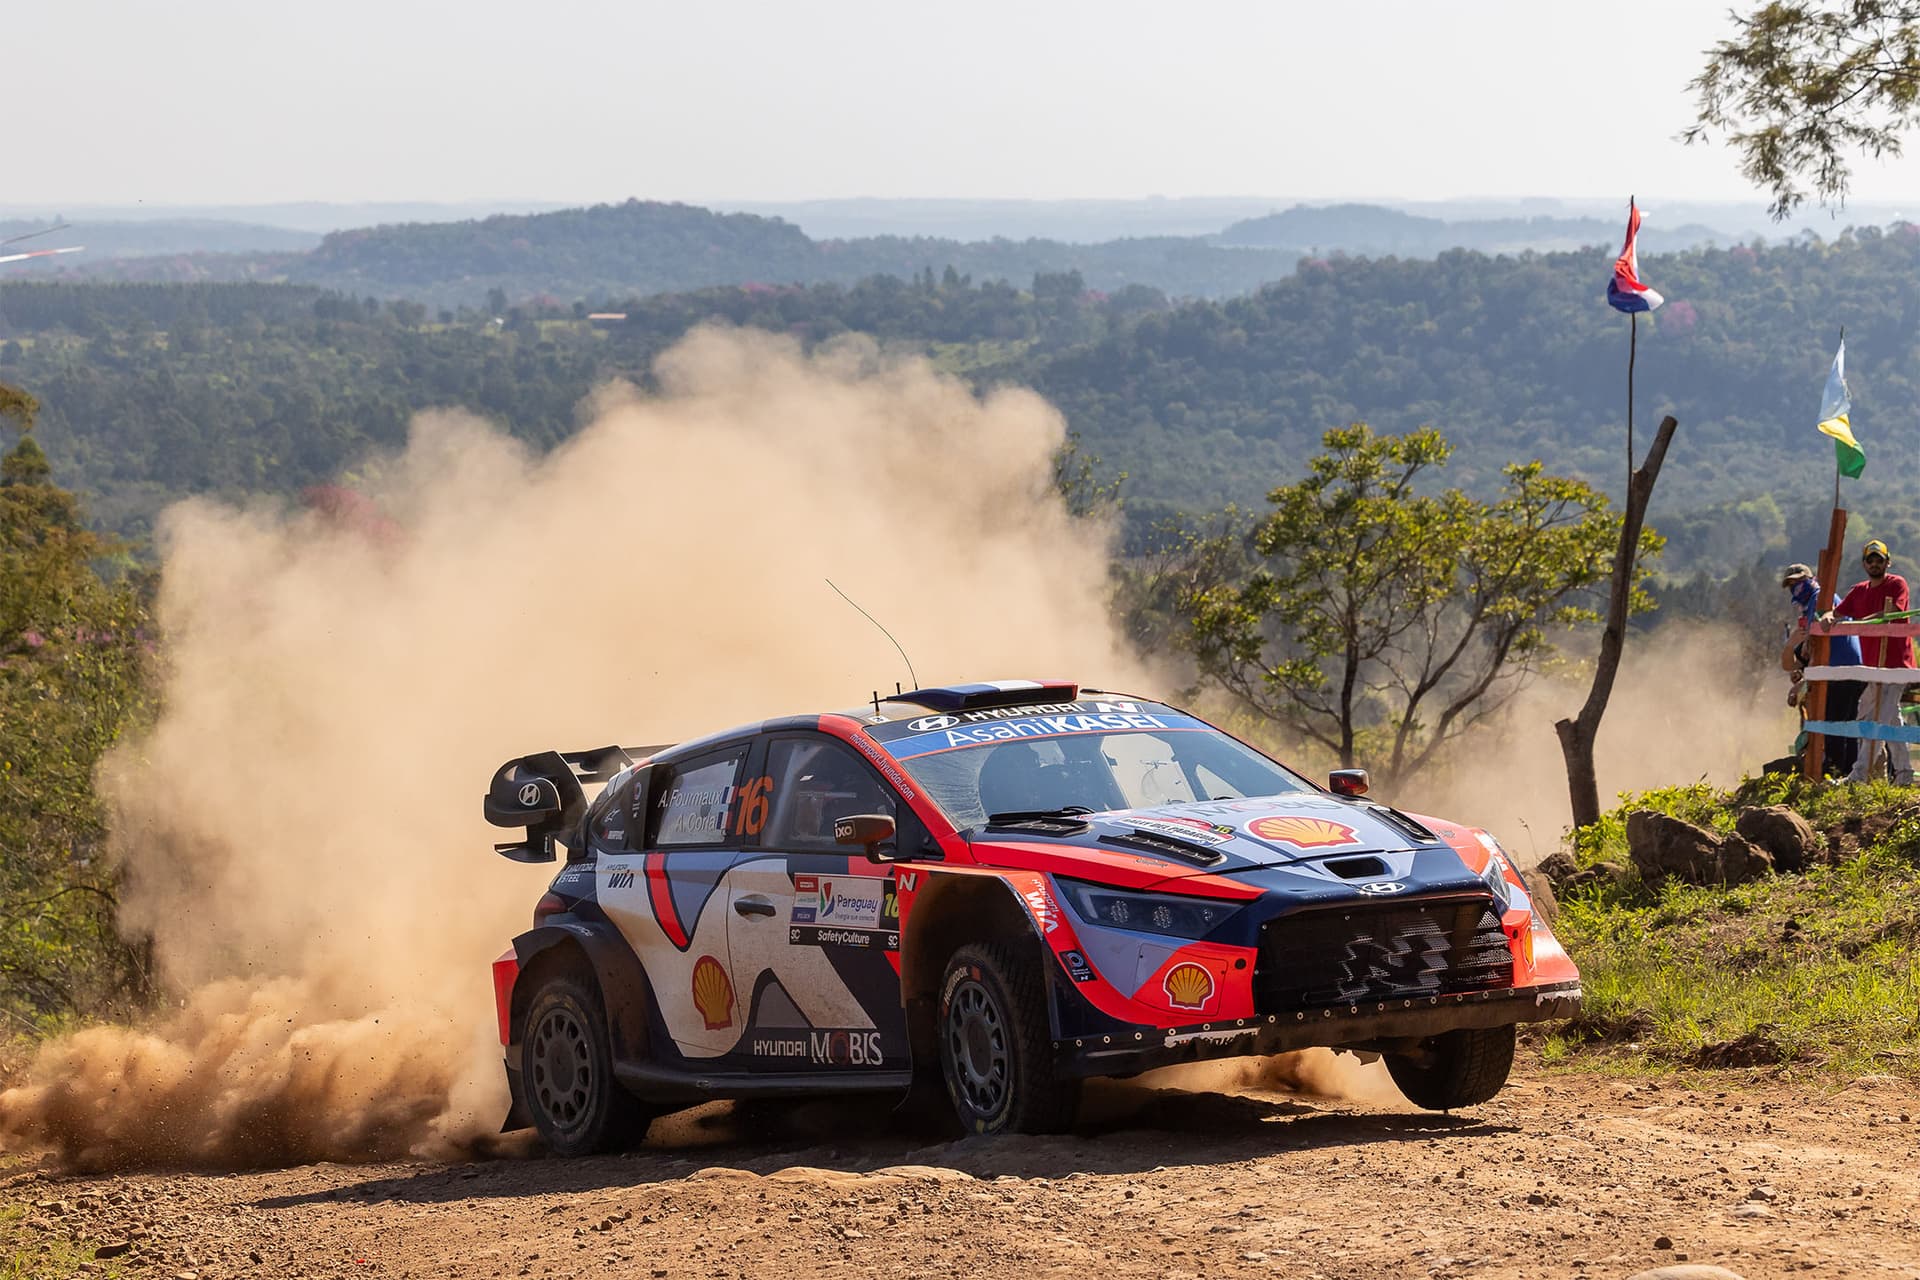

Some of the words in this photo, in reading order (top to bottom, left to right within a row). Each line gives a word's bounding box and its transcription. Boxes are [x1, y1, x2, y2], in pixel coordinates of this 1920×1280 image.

[964, 703, 1087, 721] HYUNDAI
[945, 714, 1168, 747] AsahiKASEI
[849, 733, 915, 801] motorsport.hyundai.com
[735, 776, 773, 836] 16
[899, 873, 916, 891] N
[837, 894, 879, 913] Paraguay
[790, 929, 800, 940] SC
[817, 930, 870, 944] SafetyCulture
[887, 935, 898, 946] SC
[754, 1040, 806, 1056] HYUNDAI
[810, 1031, 883, 1066] MOBIS
